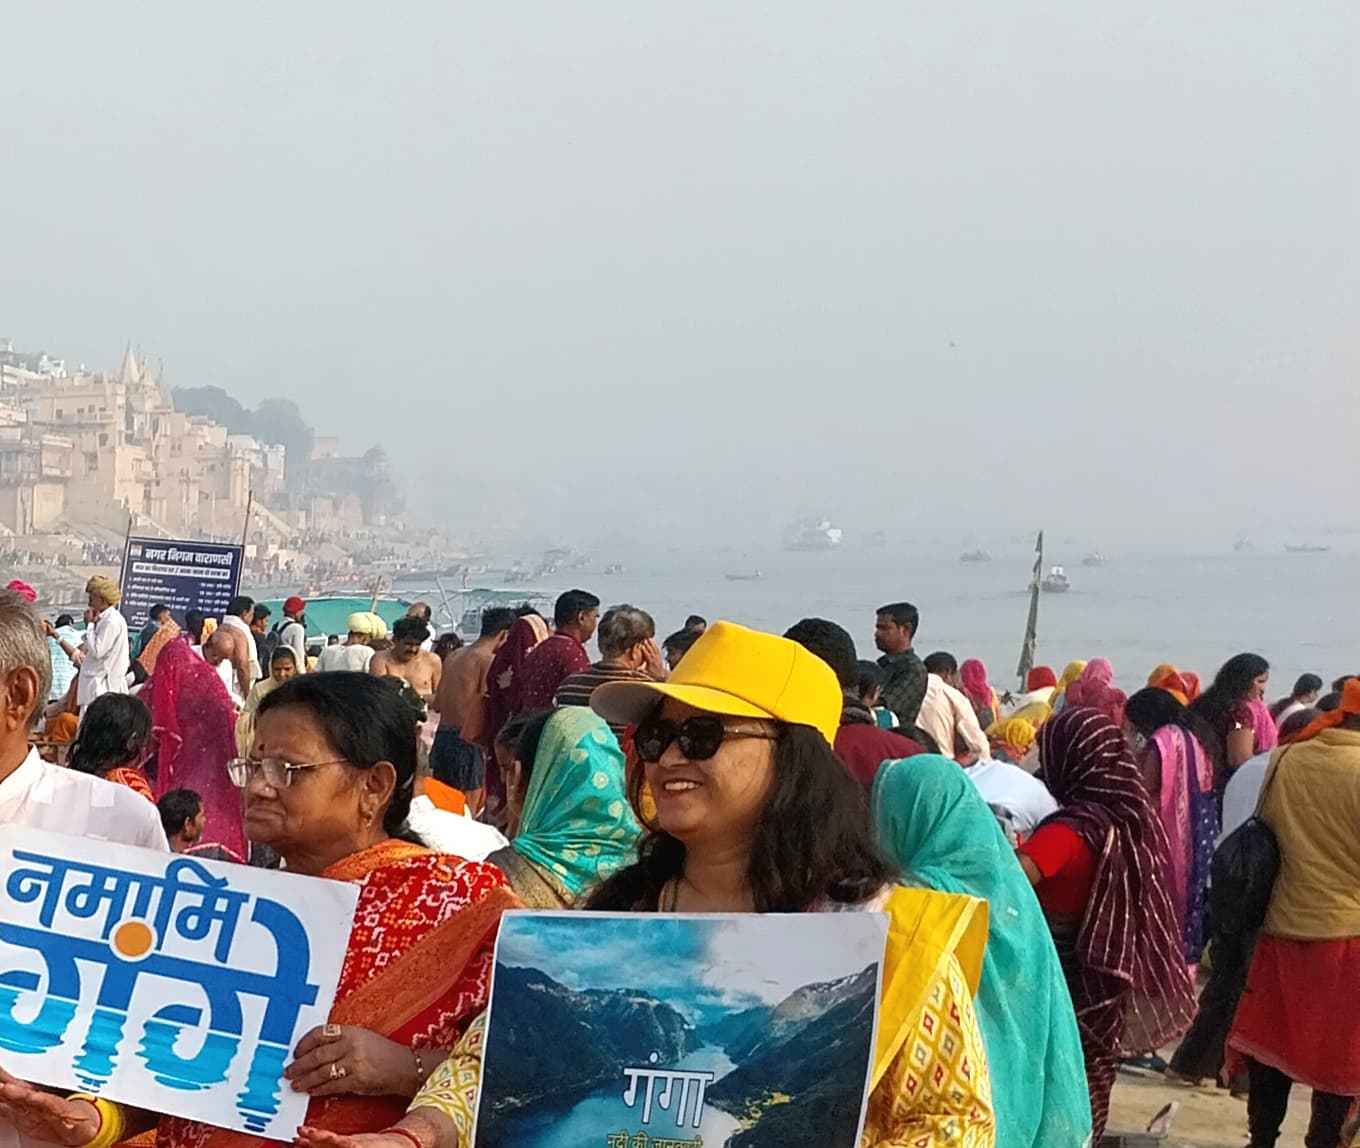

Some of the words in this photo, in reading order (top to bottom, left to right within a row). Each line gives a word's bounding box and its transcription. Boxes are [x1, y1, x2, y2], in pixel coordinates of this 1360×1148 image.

[145, 548, 166, 560] नगर
[167, 548, 193, 563] निगम
[194, 552, 233, 566] वाराणसी
[5, 849, 250, 964] नमामि
[623, 1051, 715, 1128] गंगा
